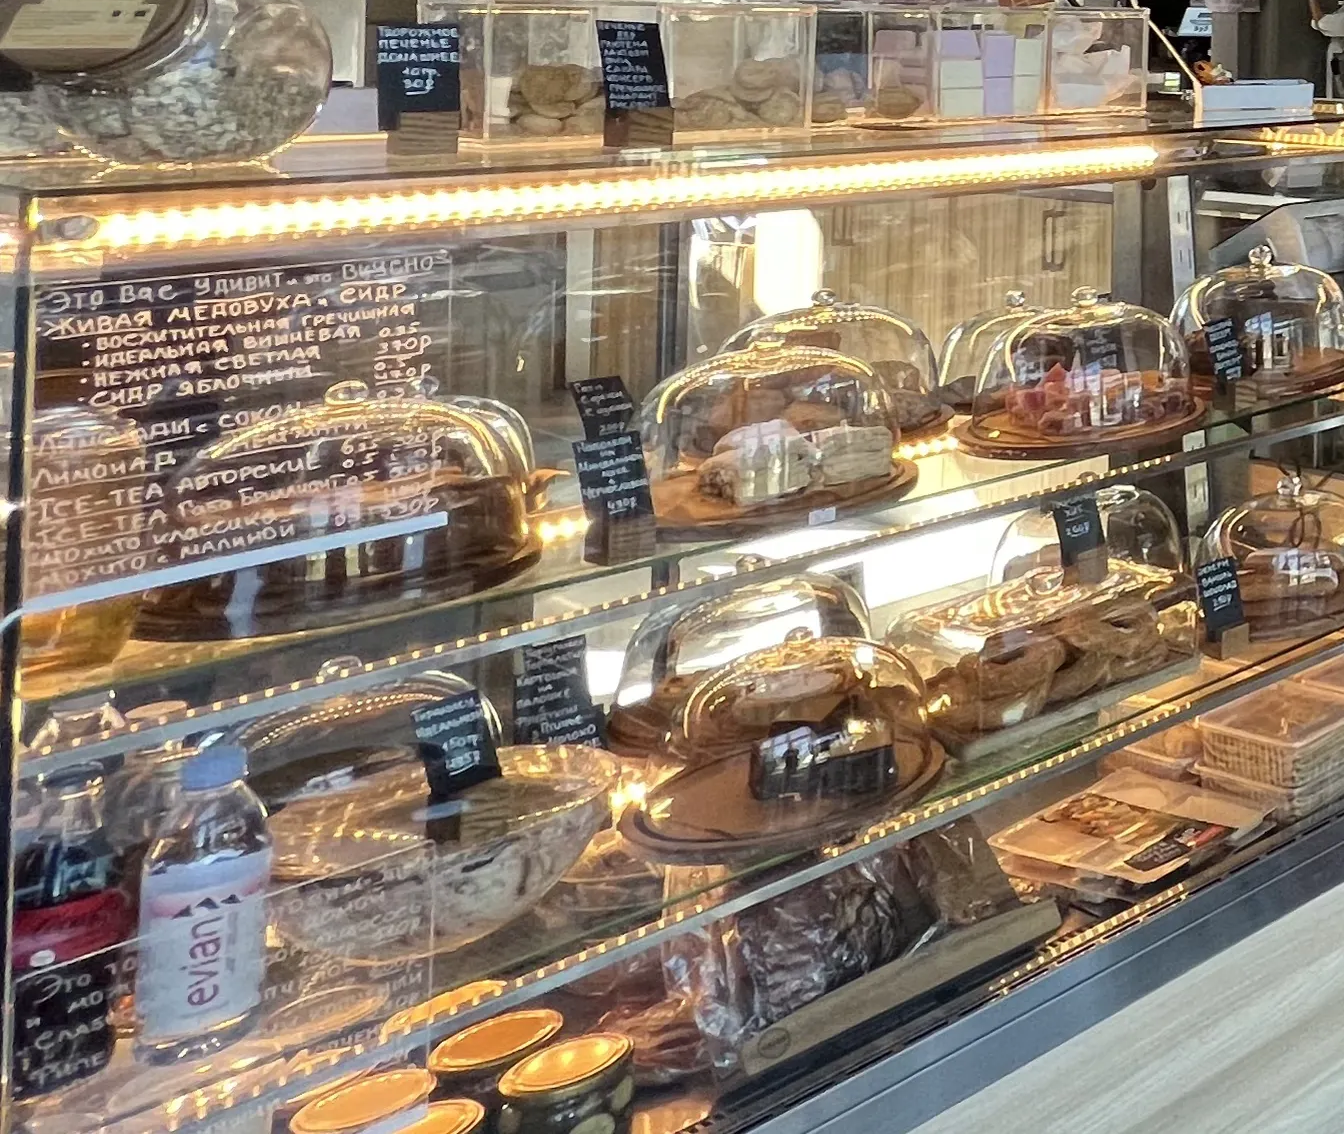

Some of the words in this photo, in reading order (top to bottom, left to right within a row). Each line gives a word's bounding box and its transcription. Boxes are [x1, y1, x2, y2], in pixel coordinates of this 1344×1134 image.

[46, 290, 105, 313] Это
[119, 283, 177, 306] Вас
[167, 293, 312, 324] МЕДОВУХА
[339, 282, 408, 305] СИДР
[186, 914, 224, 1008] evian
